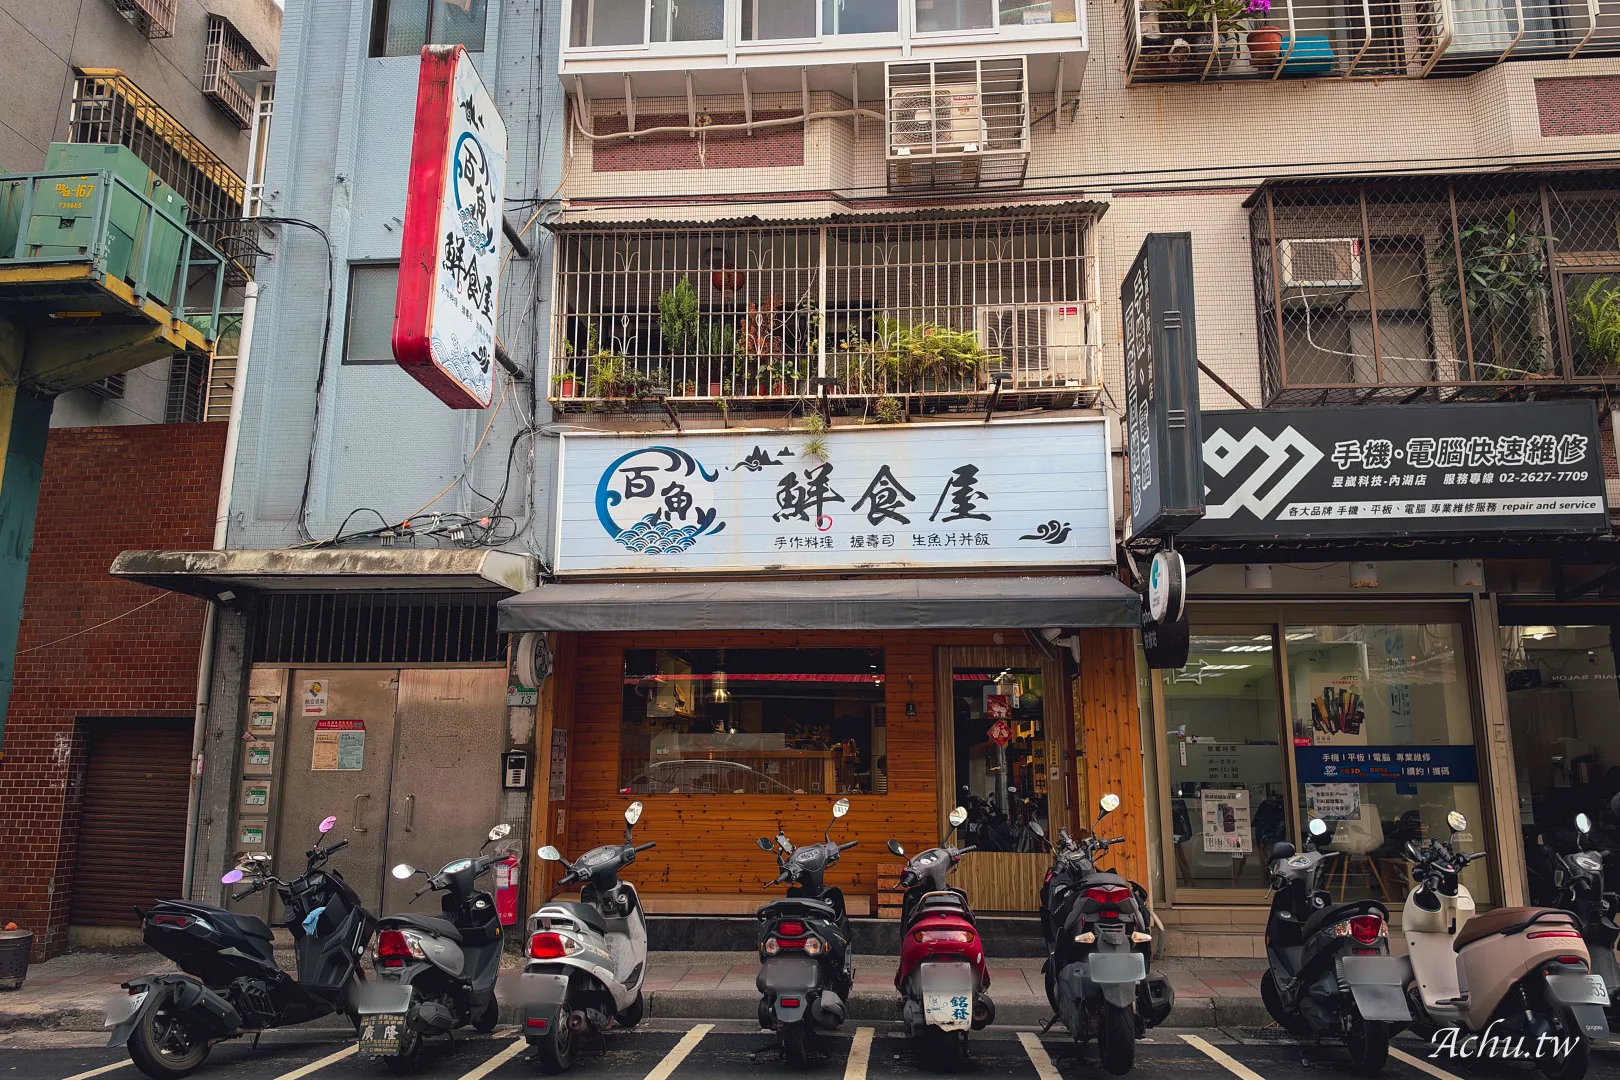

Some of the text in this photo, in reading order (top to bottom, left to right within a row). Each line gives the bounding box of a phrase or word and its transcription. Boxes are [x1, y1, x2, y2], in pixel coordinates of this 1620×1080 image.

[464, 144, 487, 227] 百魚
[442, 231, 493, 326] 鮮食屋
[1443, 472, 1494, 485] 服務專線
[1499, 470, 1588, 483] 02-2627-7709
[618, 466, 706, 526] 百魚
[772, 462, 992, 527] 鮮食屋
[1288, 505, 1333, 517] 各大品牌
[1430, 501, 1498, 514] 專業維修服務
[1502, 501, 1534, 512] repair
[1536, 500, 1556, 510] and
[1559, 500, 1596, 510] service
[774, 534, 834, 549] 手作料理
[849, 533, 895, 548] 握壽司
[520, 695, 532, 705] 13
[1395, 752, 1431, 762] 專業維修
